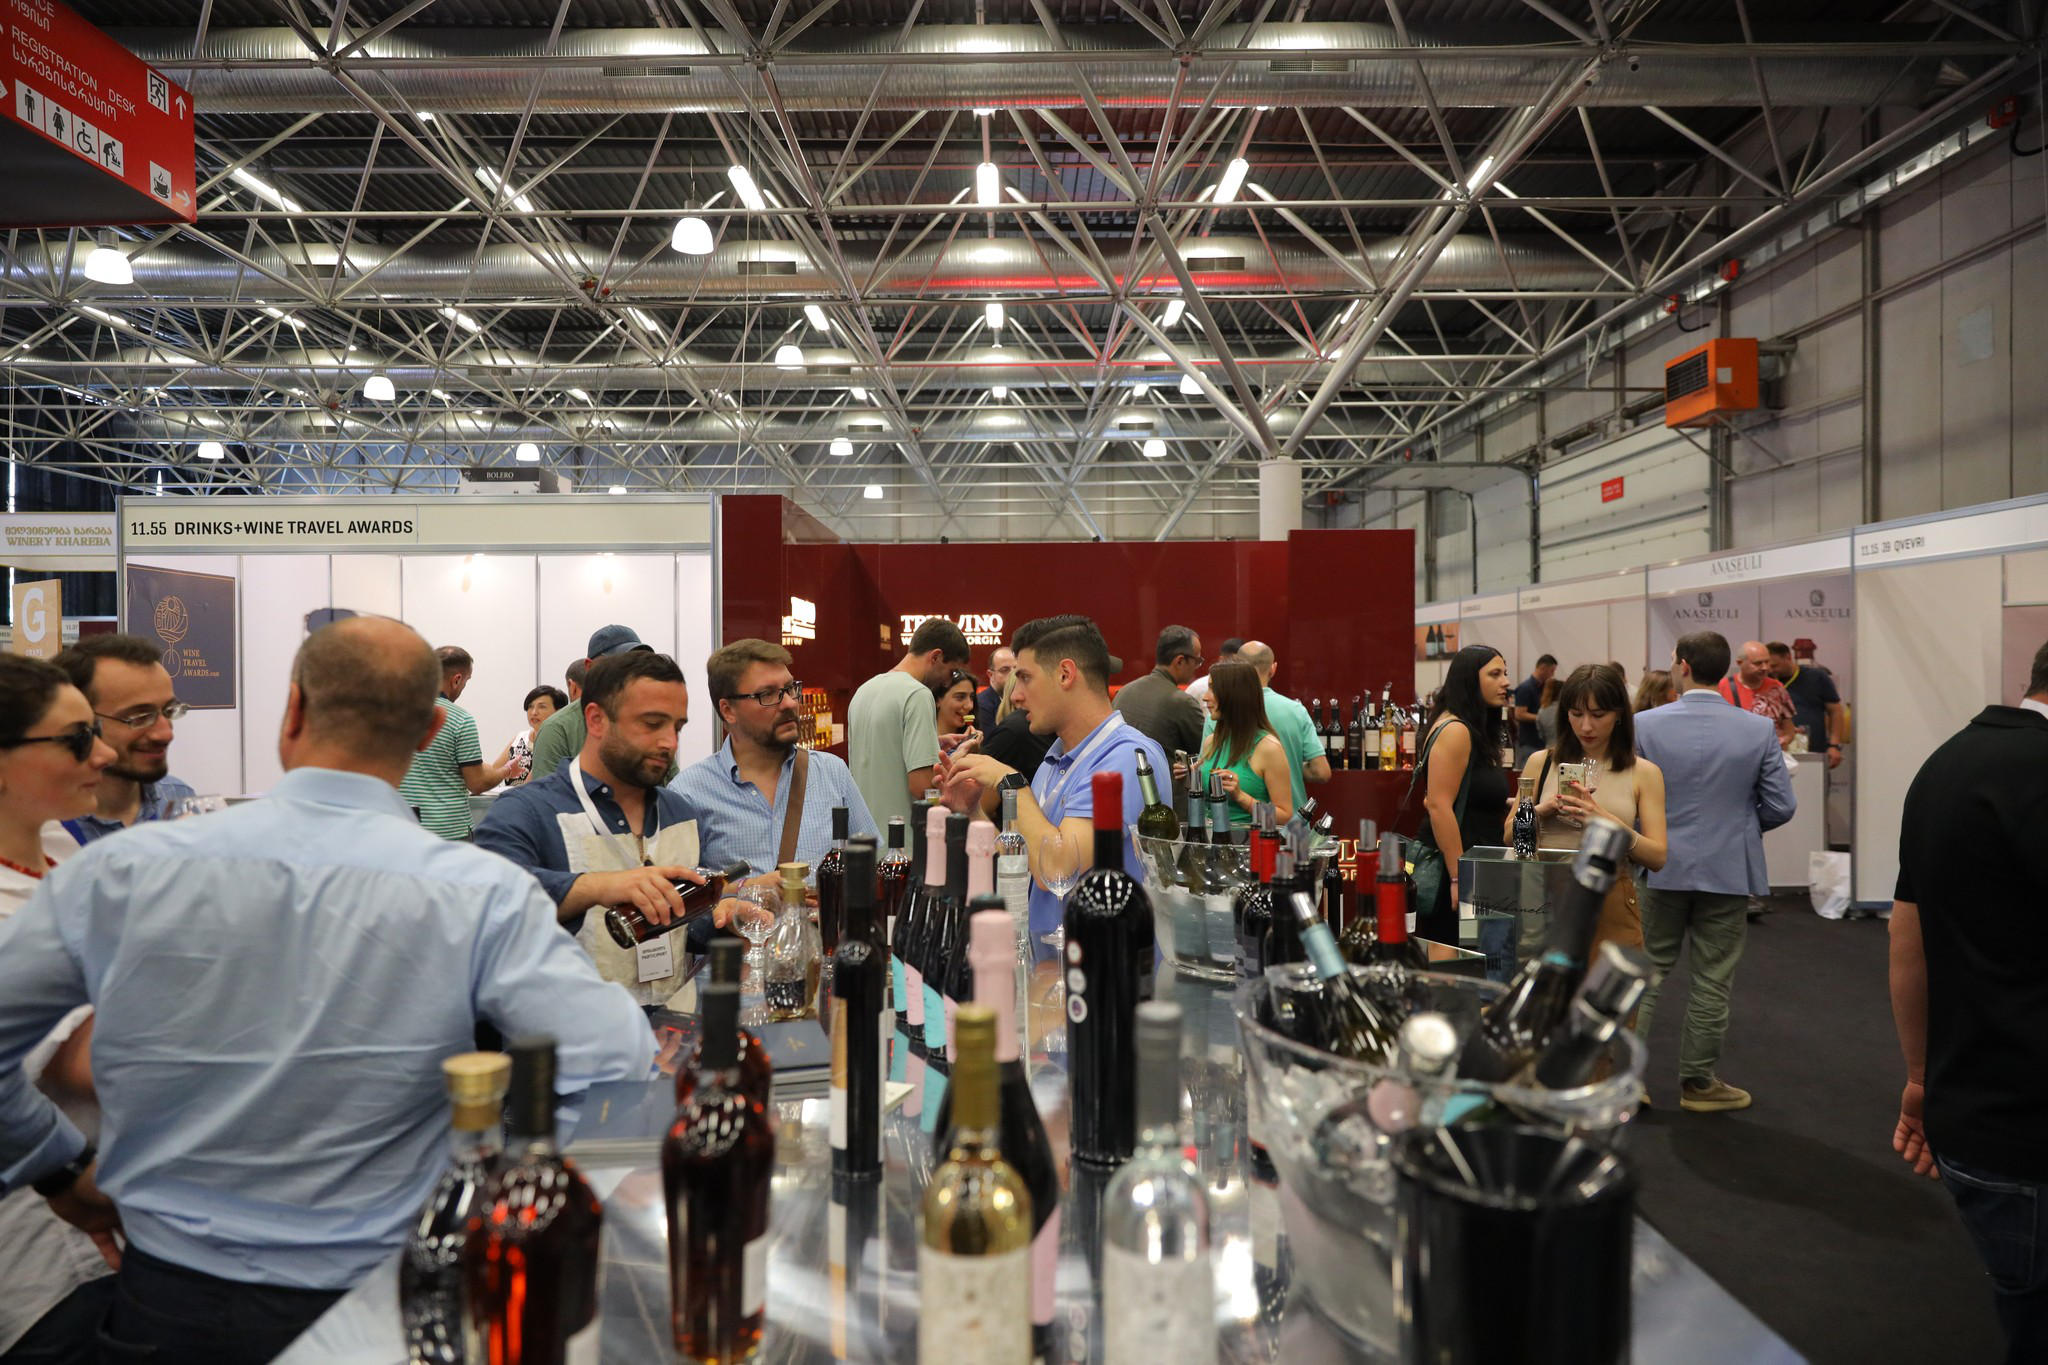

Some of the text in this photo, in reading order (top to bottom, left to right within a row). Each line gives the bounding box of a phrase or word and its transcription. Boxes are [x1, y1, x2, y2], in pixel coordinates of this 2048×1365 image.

[12, 25, 136, 117] REGISTRATION DESK
[486, 471, 514, 479] BOLERO
[131, 520, 413, 536] 11.55 DRINKS+WINE TRAVEL AWARDS
[7, 536, 111, 547] WINERY KHAREBA
[1711, 554, 1762, 576] ANASEULI
[1673, 609, 1740, 619] ANASEULI
[1785, 608, 1851, 618] ANASEULI
[183, 658, 207, 667] TRAVEL
